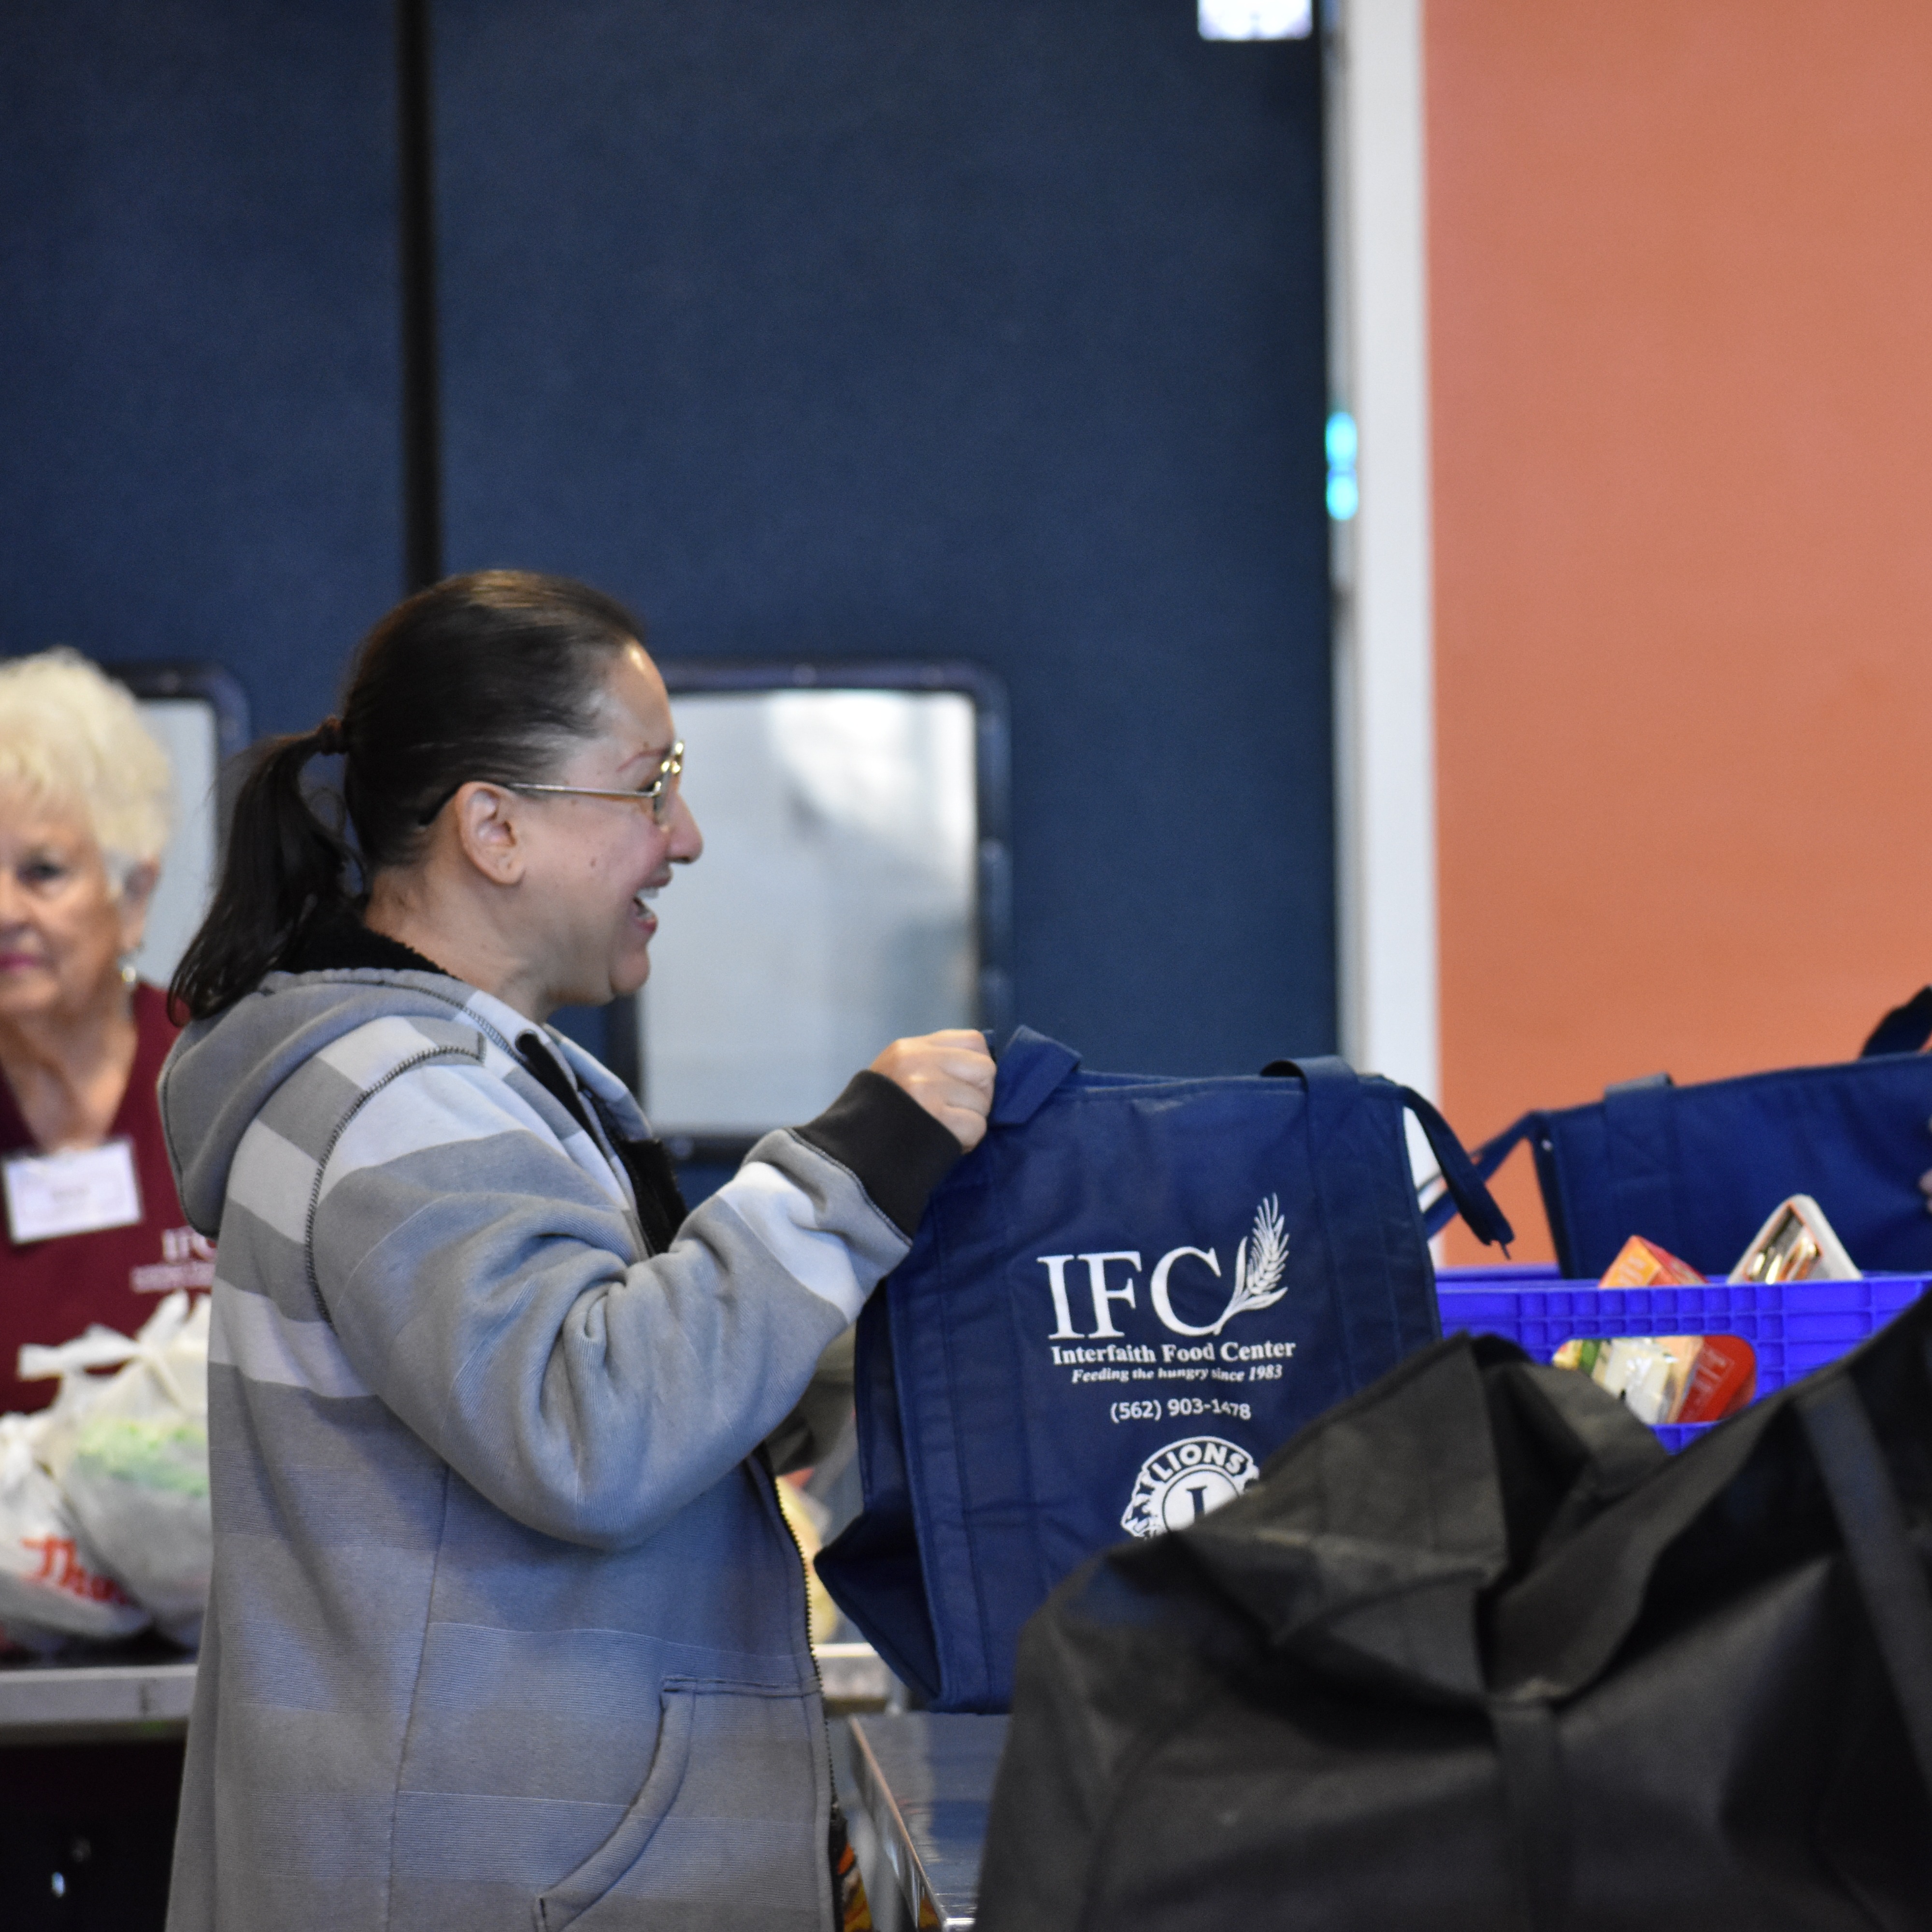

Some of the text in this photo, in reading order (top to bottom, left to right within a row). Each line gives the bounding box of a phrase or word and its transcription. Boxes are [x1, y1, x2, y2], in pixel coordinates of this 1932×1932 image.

[1036, 1246, 1222, 1340] IFC
[1051, 1340, 1296, 1365] Interfaith Food Center
[1071, 1363, 1283, 1384] Feeding the hungry since 1983
[1110, 1398, 1252, 1424] (562) 903-1478
[1151, 1442, 1245, 1481] LIONS
